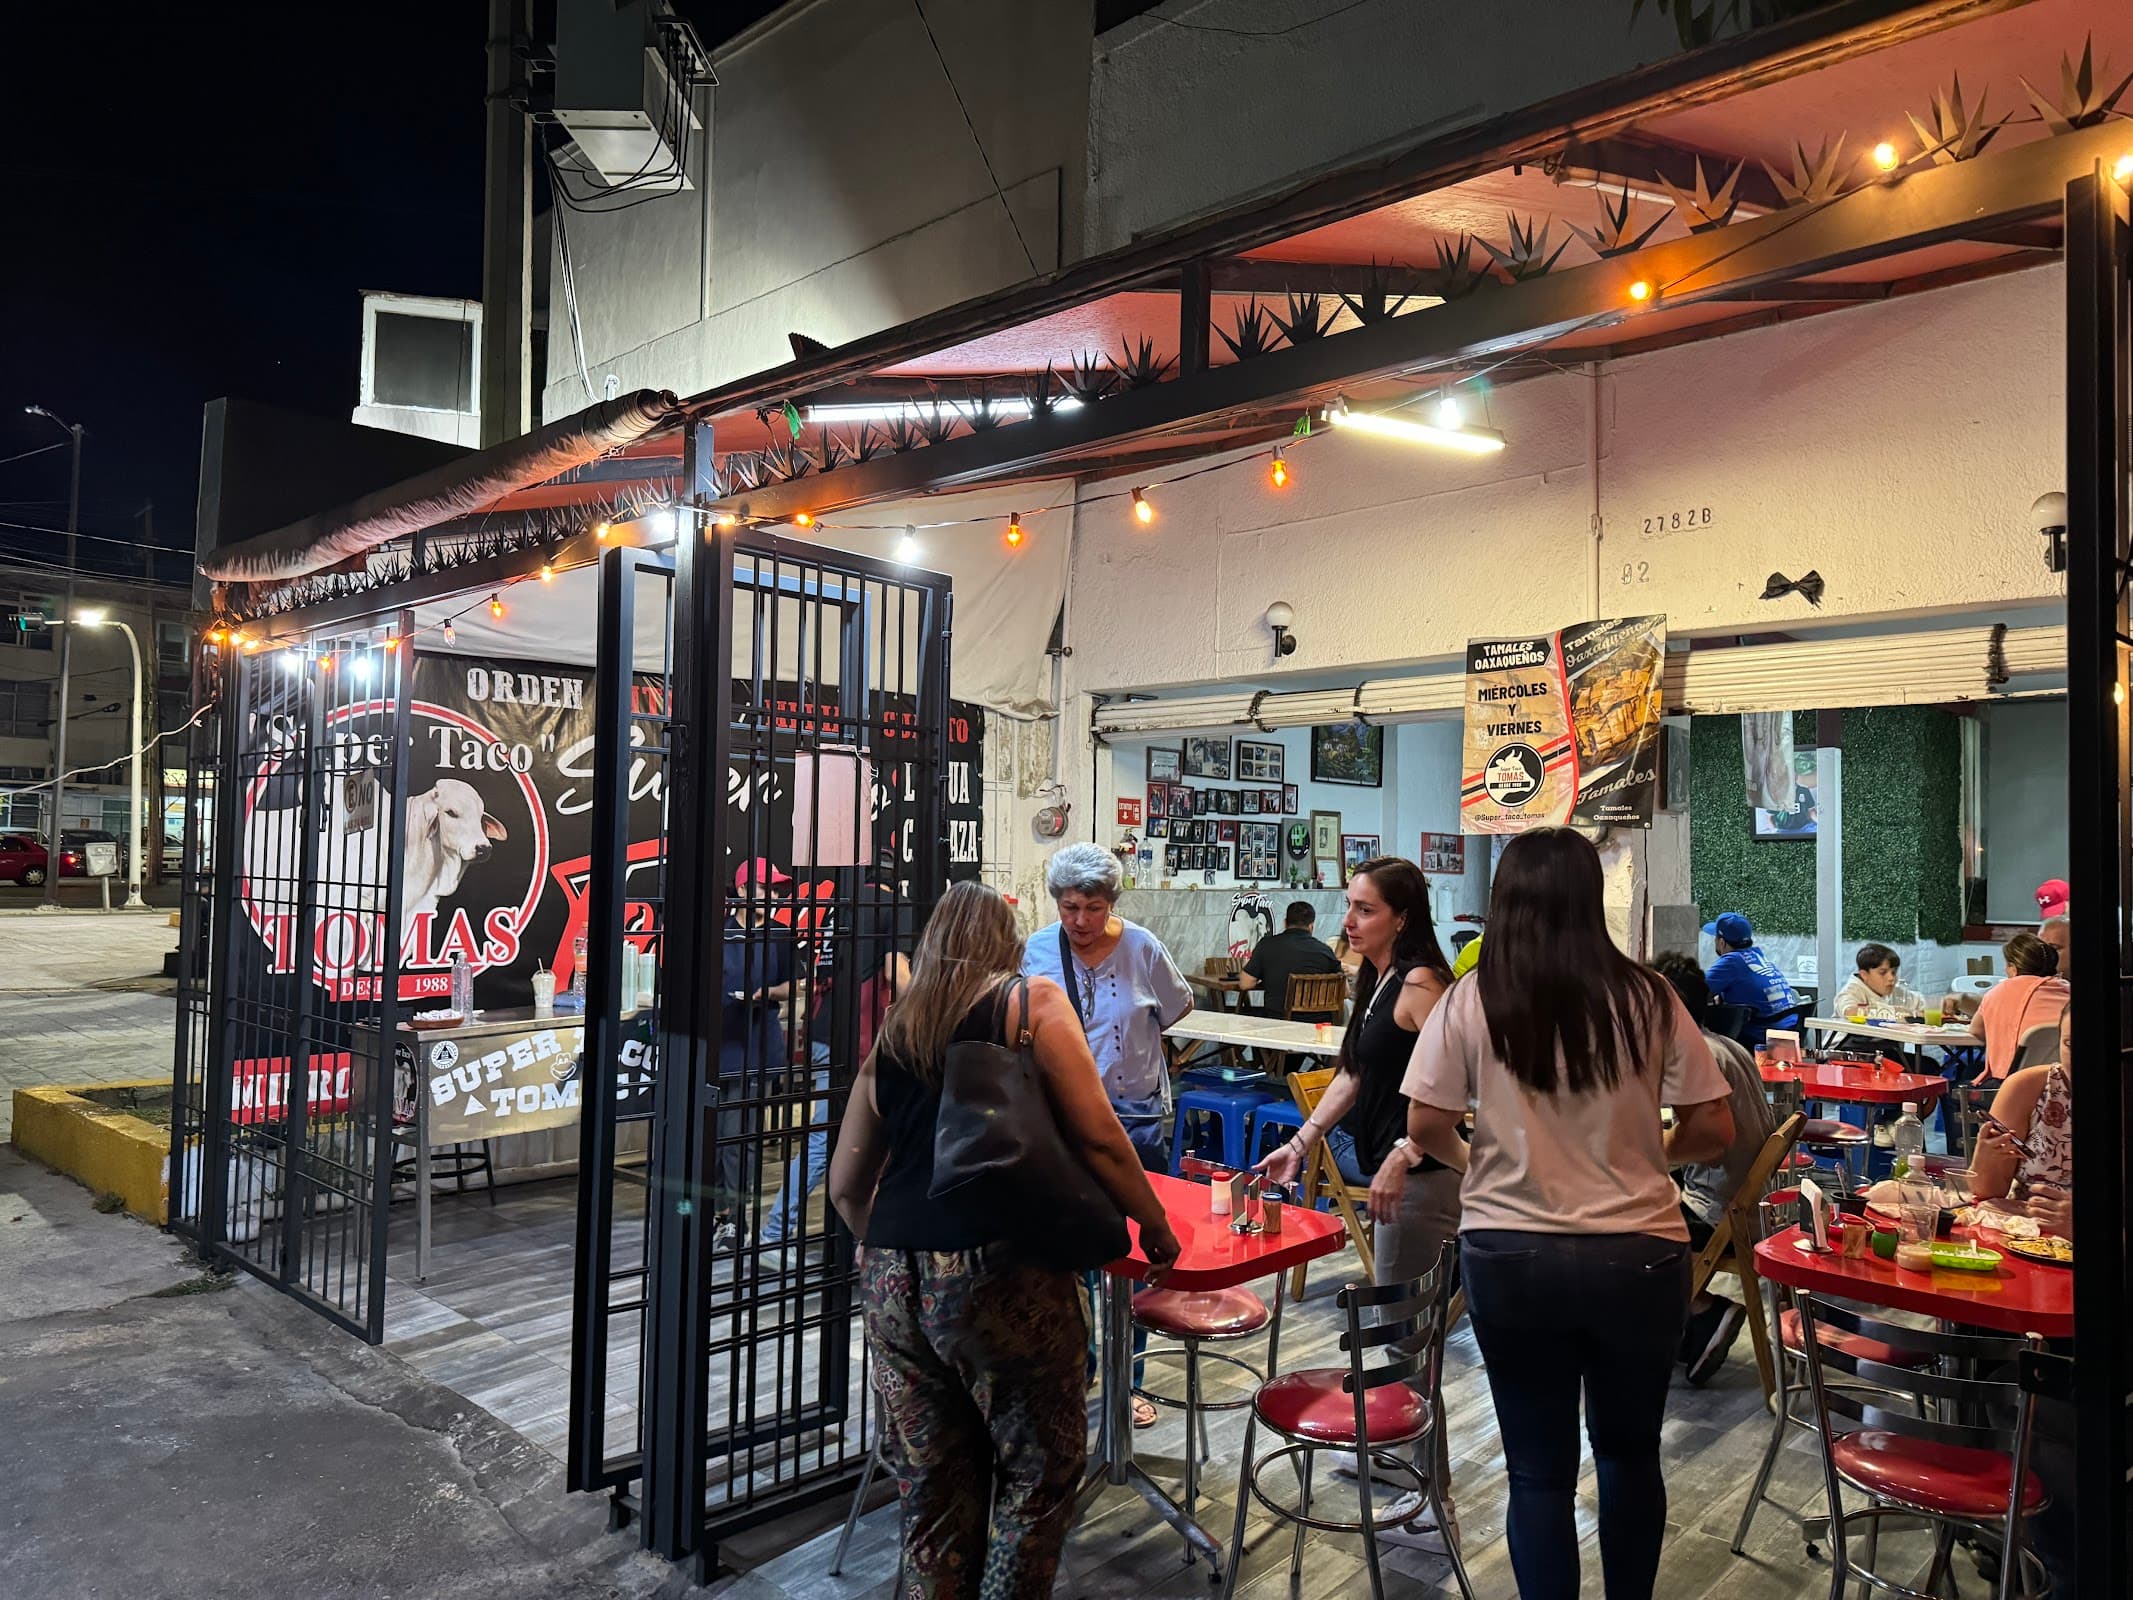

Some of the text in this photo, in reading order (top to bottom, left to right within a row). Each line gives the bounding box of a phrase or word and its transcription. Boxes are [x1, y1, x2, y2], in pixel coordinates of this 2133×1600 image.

[1644, 507, 1712, 534] 2782B
[1564, 617, 1624, 651] Tamales
[1483, 641, 1534, 657] TAMALES
[1474, 650, 1545, 670] OAXAQUEÑOS
[467, 667, 584, 710] ORDEN
[1478, 682, 1547, 701] MIÉRCOLES
[1508, 703, 1516, 716] Y
[1487, 720, 1542, 737] VIERNES
[1498, 772, 1525, 781] TOMAS
[1576, 768, 1656, 806] Tamales
[415, 977, 449, 993] 1988
[430, 1029, 562, 1106] SUPER
